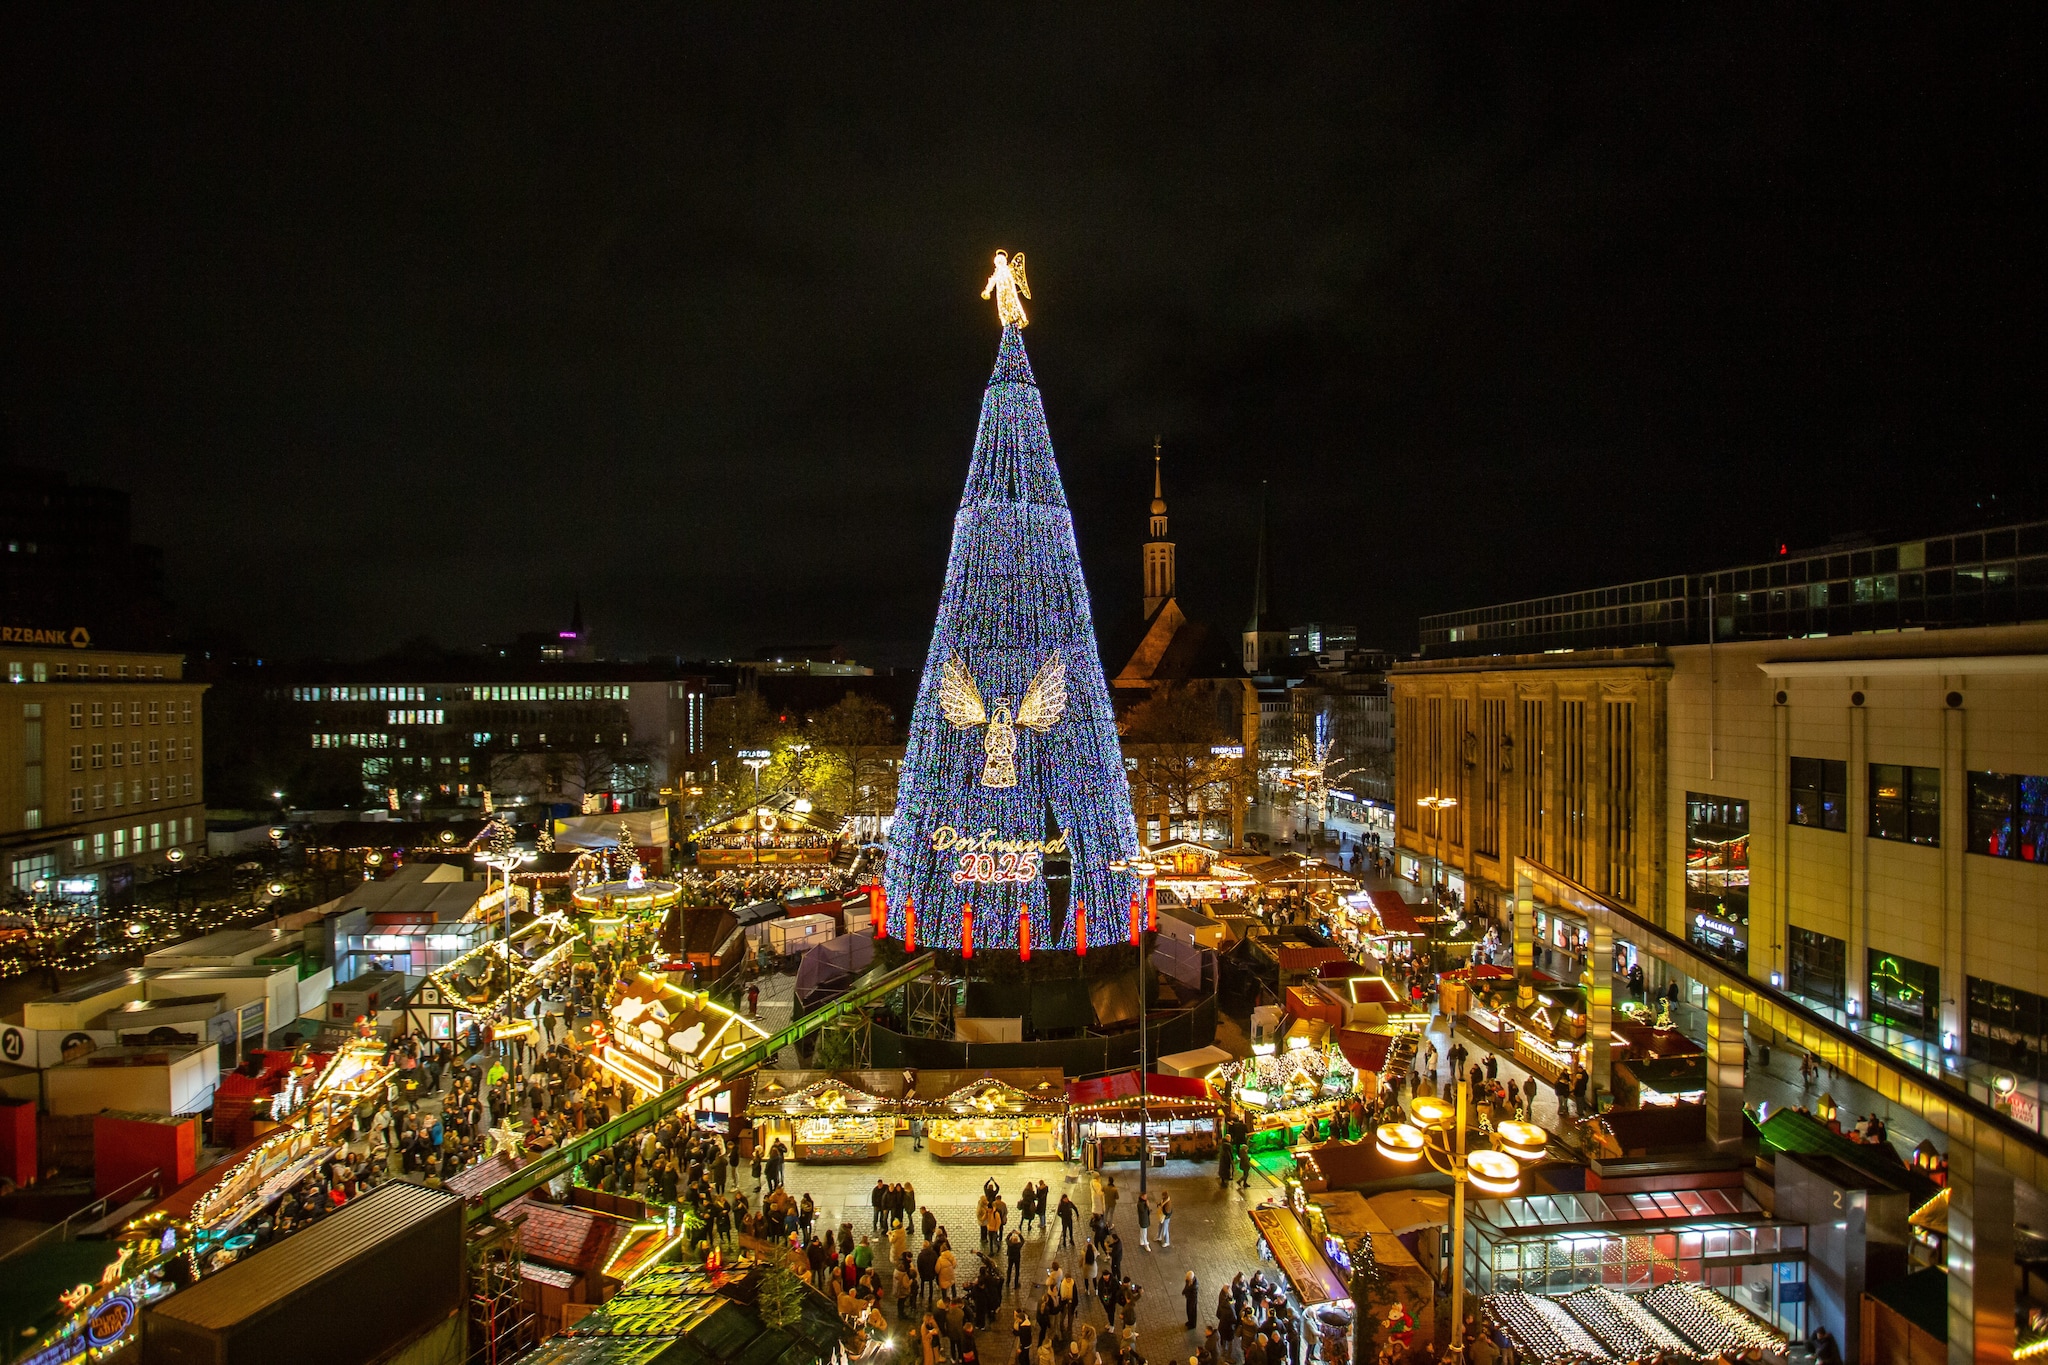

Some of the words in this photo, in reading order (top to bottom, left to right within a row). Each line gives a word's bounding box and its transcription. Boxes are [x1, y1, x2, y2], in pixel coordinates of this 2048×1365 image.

[0, 626, 67, 644] RZBANK
[932, 825, 1071, 855] Dortmund
[953, 852, 1039, 884] 2025
[1705, 919, 1735, 936] GALERIA
[6, 1033, 20, 1056] 21
[1832, 1190, 1843, 1210] 2
